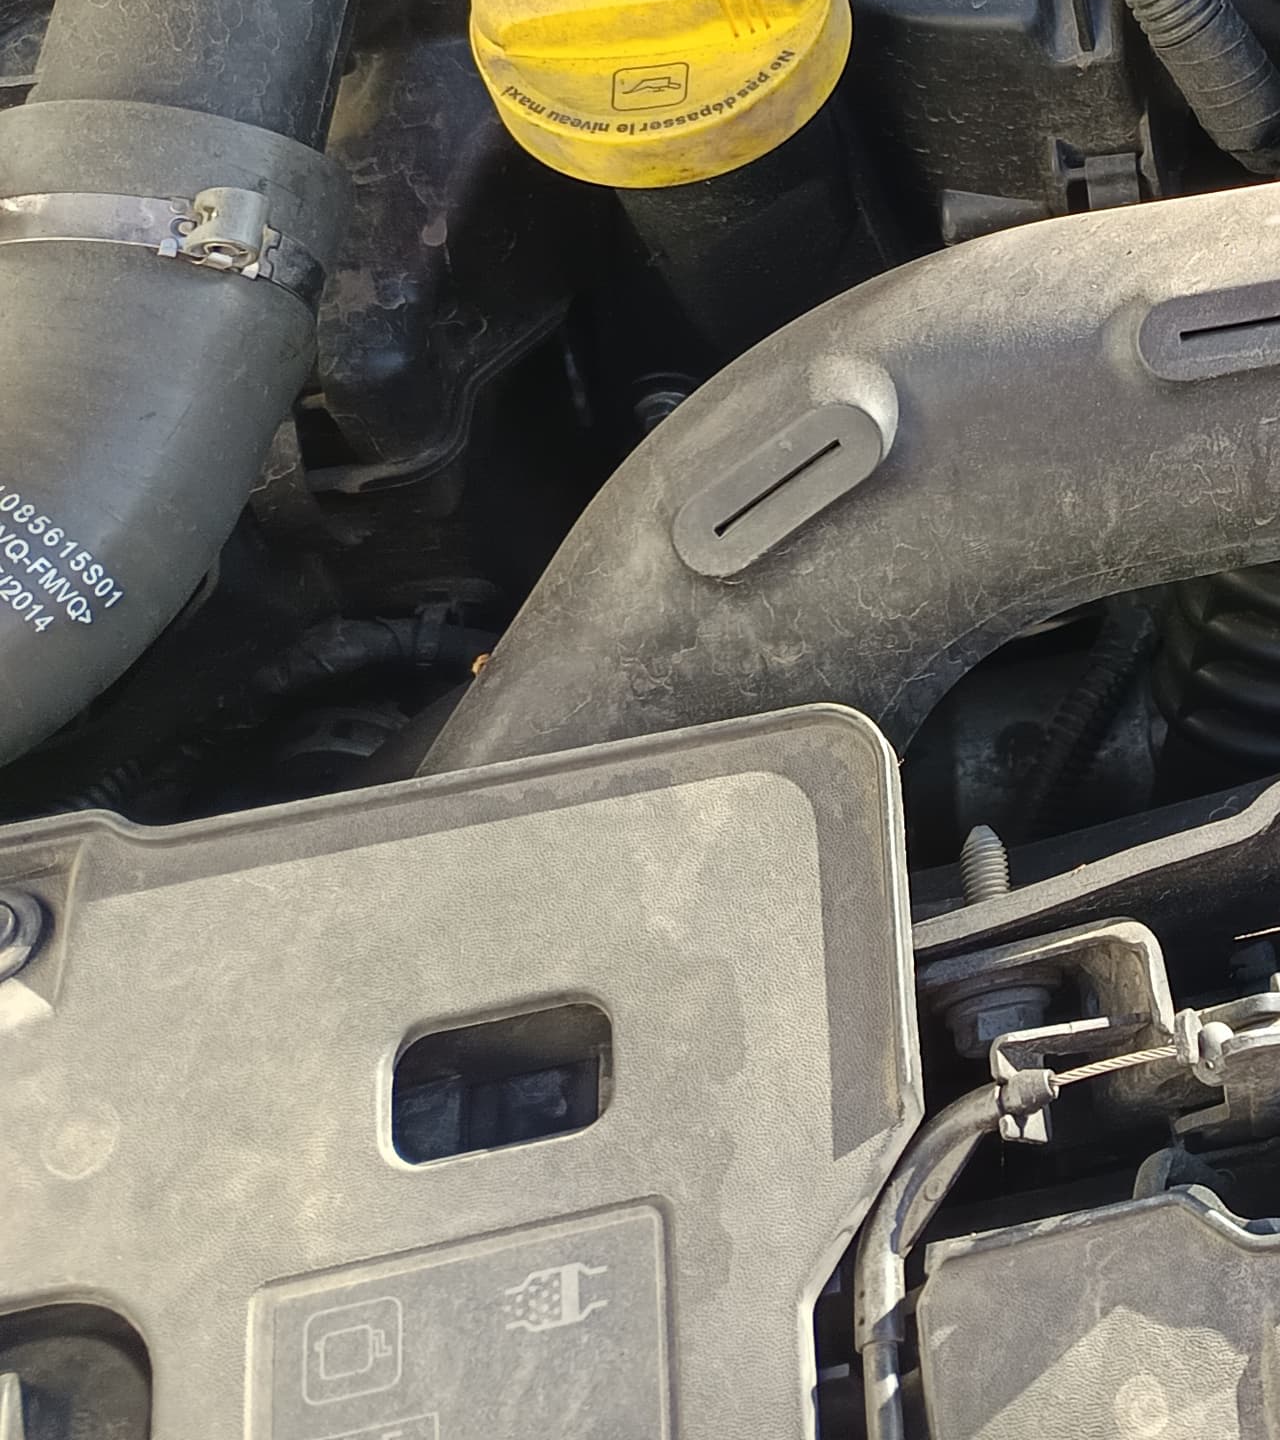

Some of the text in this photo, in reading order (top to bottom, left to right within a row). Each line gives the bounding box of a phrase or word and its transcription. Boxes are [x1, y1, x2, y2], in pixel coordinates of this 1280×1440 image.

[502, 84, 547, 116] maxi
[737, 72, 769, 97] pas
[546, 109, 610, 134] niveau
[616, 123, 635, 136] le
[638, 95, 736, 133] dépasser
[0, 486, 123, 608] 085615S01
[0, 566, 54, 632] /2014
